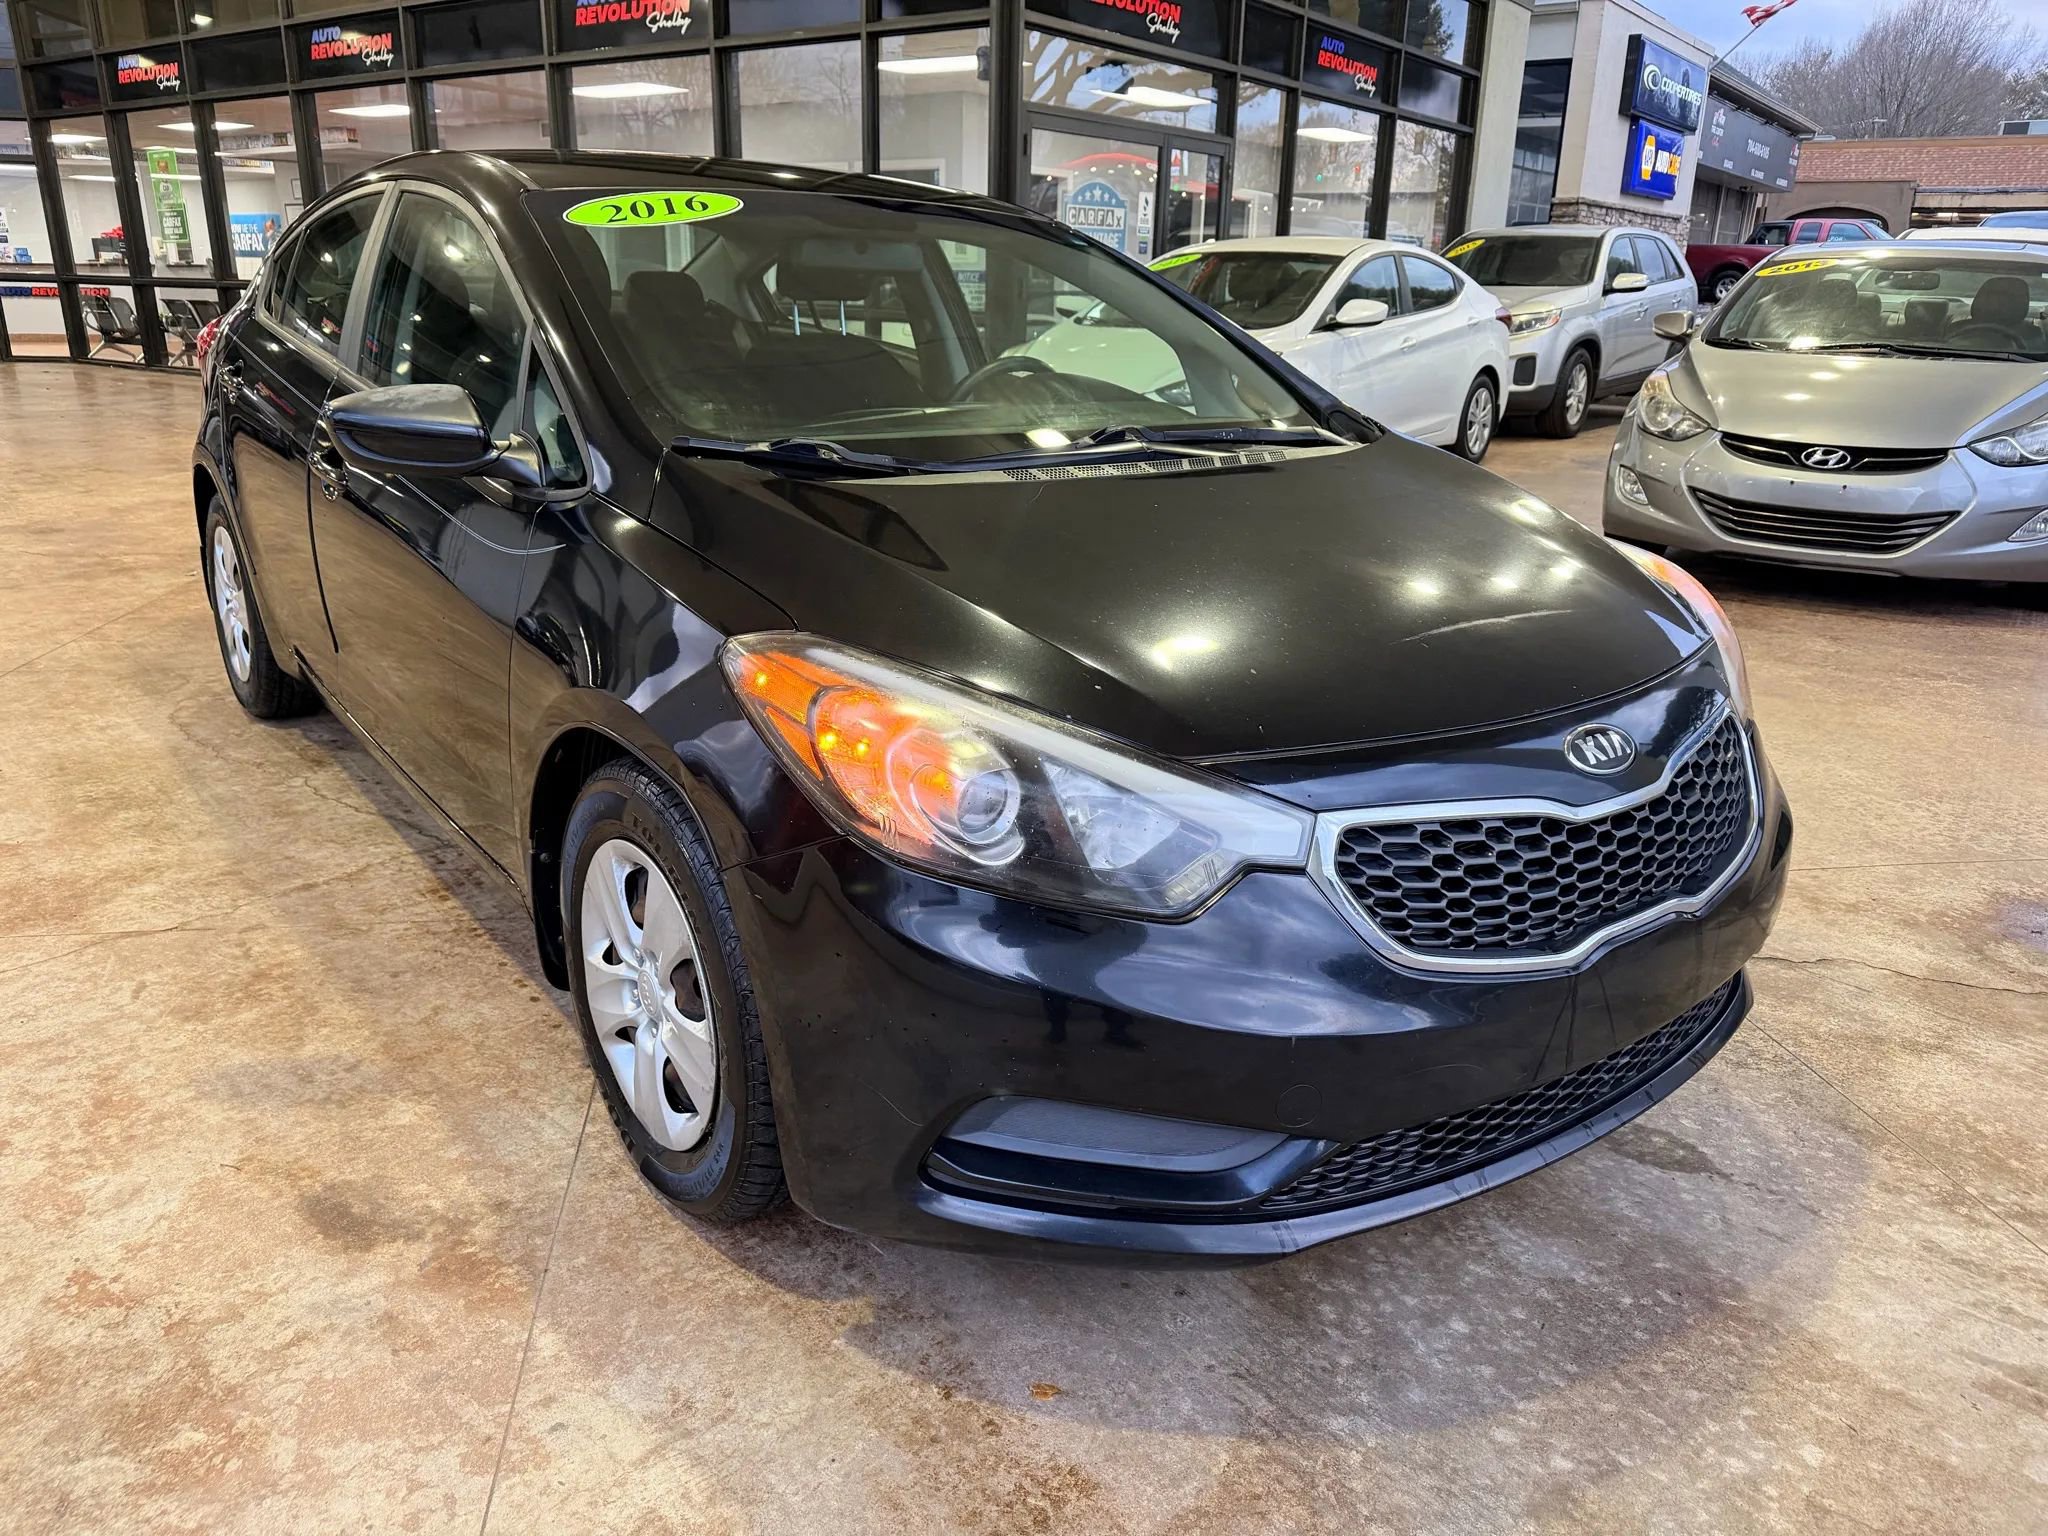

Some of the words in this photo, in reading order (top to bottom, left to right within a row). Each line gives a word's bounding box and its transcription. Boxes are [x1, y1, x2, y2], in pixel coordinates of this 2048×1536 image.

[576, 0, 690, 25] REVOLUTION
[646, 8, 691, 35] Shelby
[1090, 0, 1181, 23] OLUTION
[311, 26, 341, 43] AUTO
[1146, 13, 1180, 44] Shelby
[311, 33, 392, 60] REVOLUTION
[1320, 36, 1345, 54] AUTO
[362, 47, 394, 68] Shelby
[1318, 49, 1378, 82] REVOLUTION
[118, 61, 178, 84] REVOLUTION
[156, 74, 180, 92] Shelby
[600, 194, 710, 223] 2016
[1068, 207, 1122, 228] CARFAX
[232, 233, 265, 252] ARFAX
[32, 286, 110, 297] REVOTION
[1575, 730, 1631, 765] KIA
